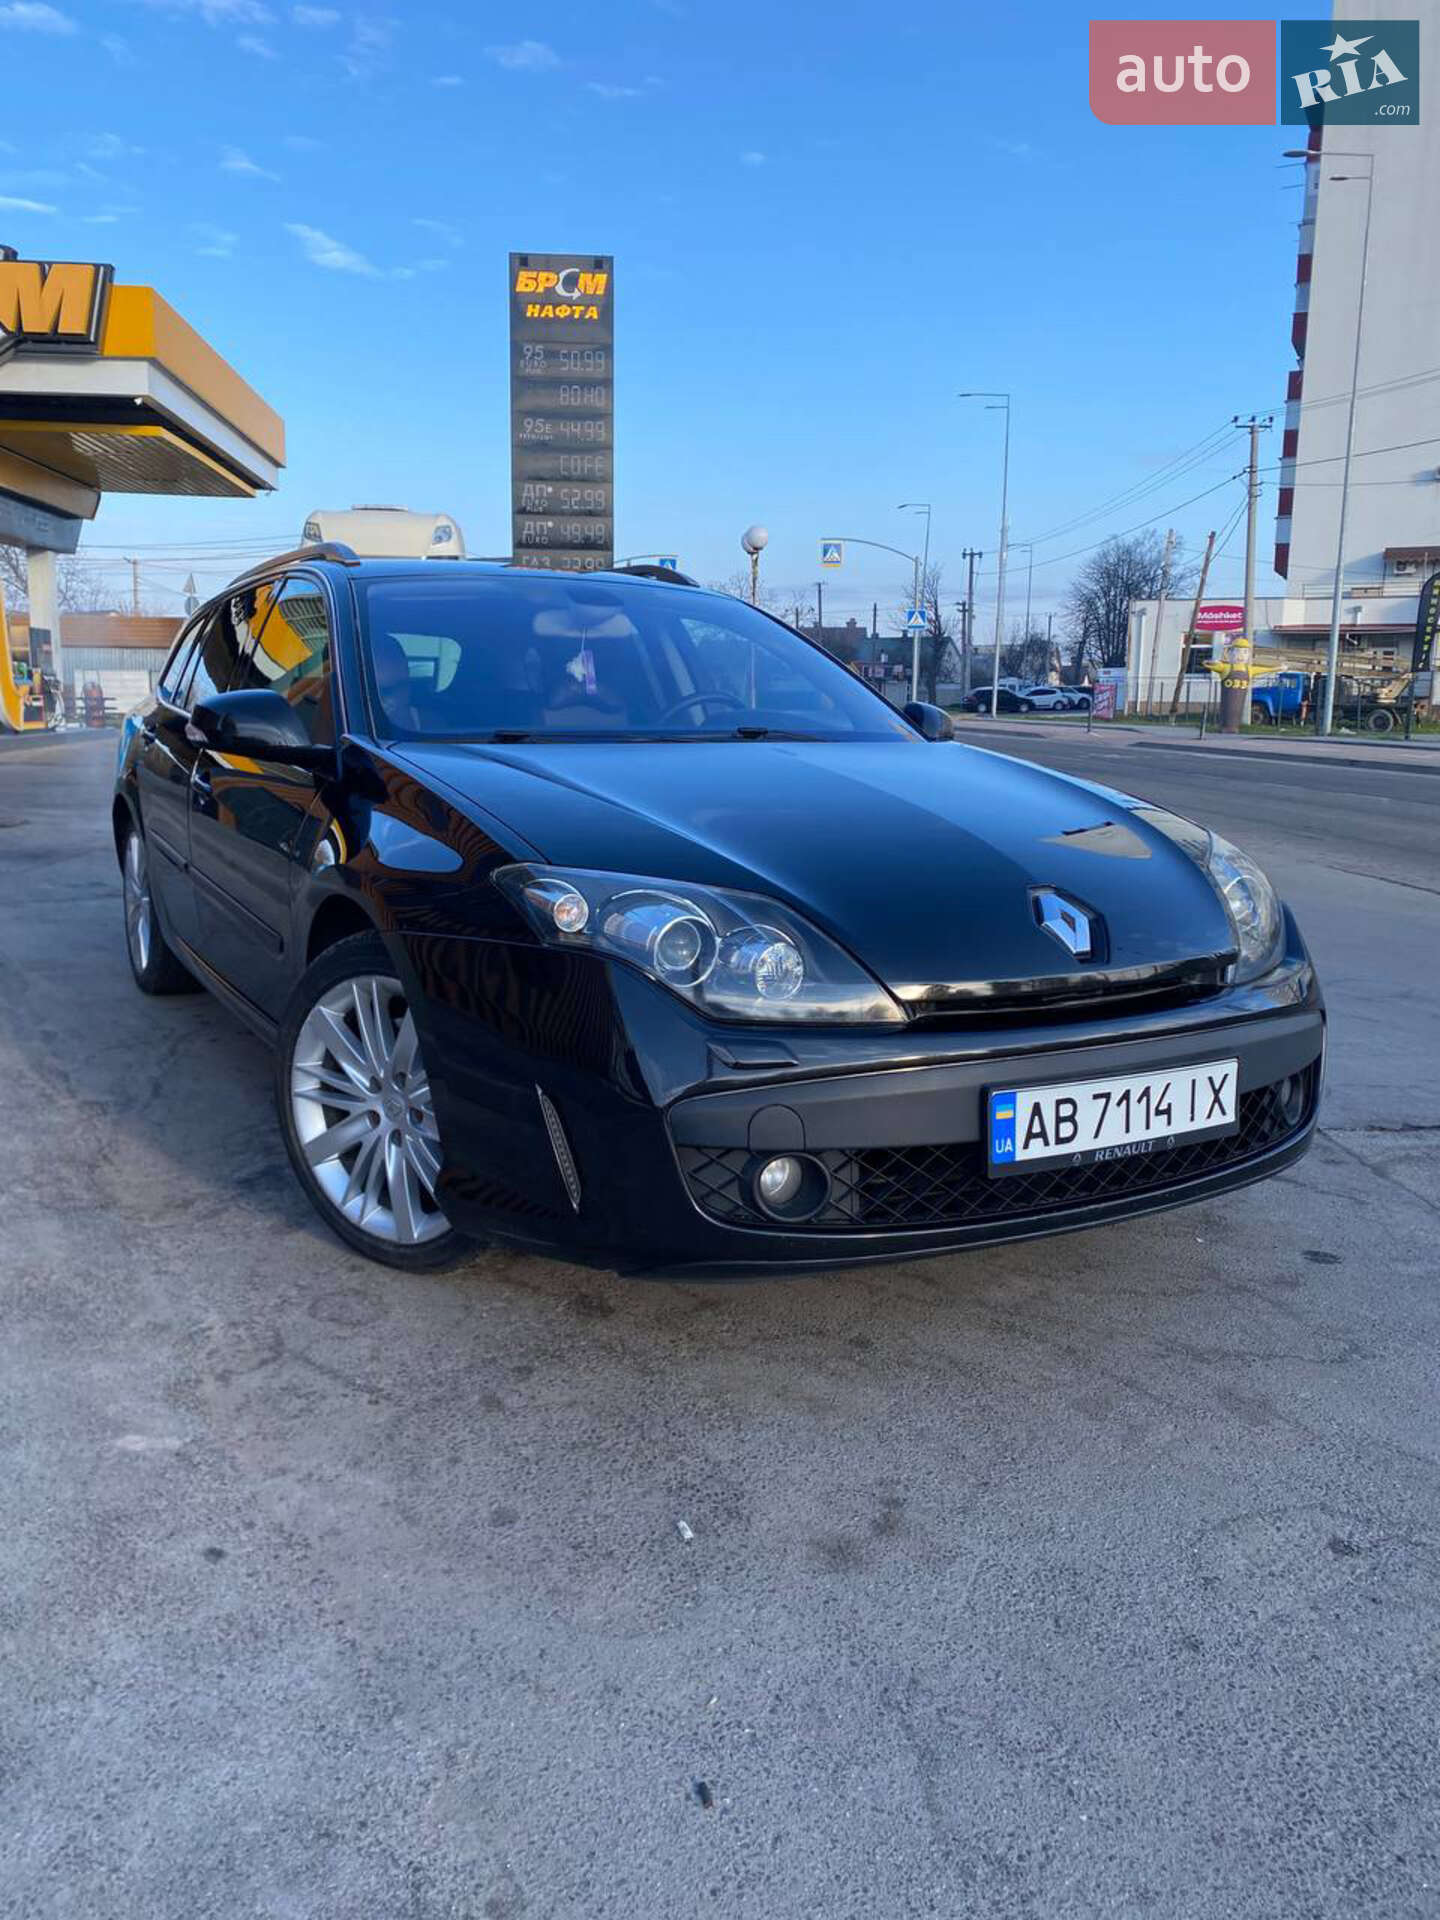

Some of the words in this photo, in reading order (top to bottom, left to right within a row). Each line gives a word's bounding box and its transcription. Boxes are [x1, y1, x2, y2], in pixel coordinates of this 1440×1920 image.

[515, 268, 608, 299] БРСМ
[526, 304, 599, 319] НАФТА
[523, 345, 544, 361] 95
[1022, 1097, 1079, 1150] AB
[1092, 1082, 1172, 1140] 7114
[1189, 1073, 1229, 1122] IX
[996, 1138, 1013, 1153] UA
[1094, 1141, 1154, 1161] RENAULT
